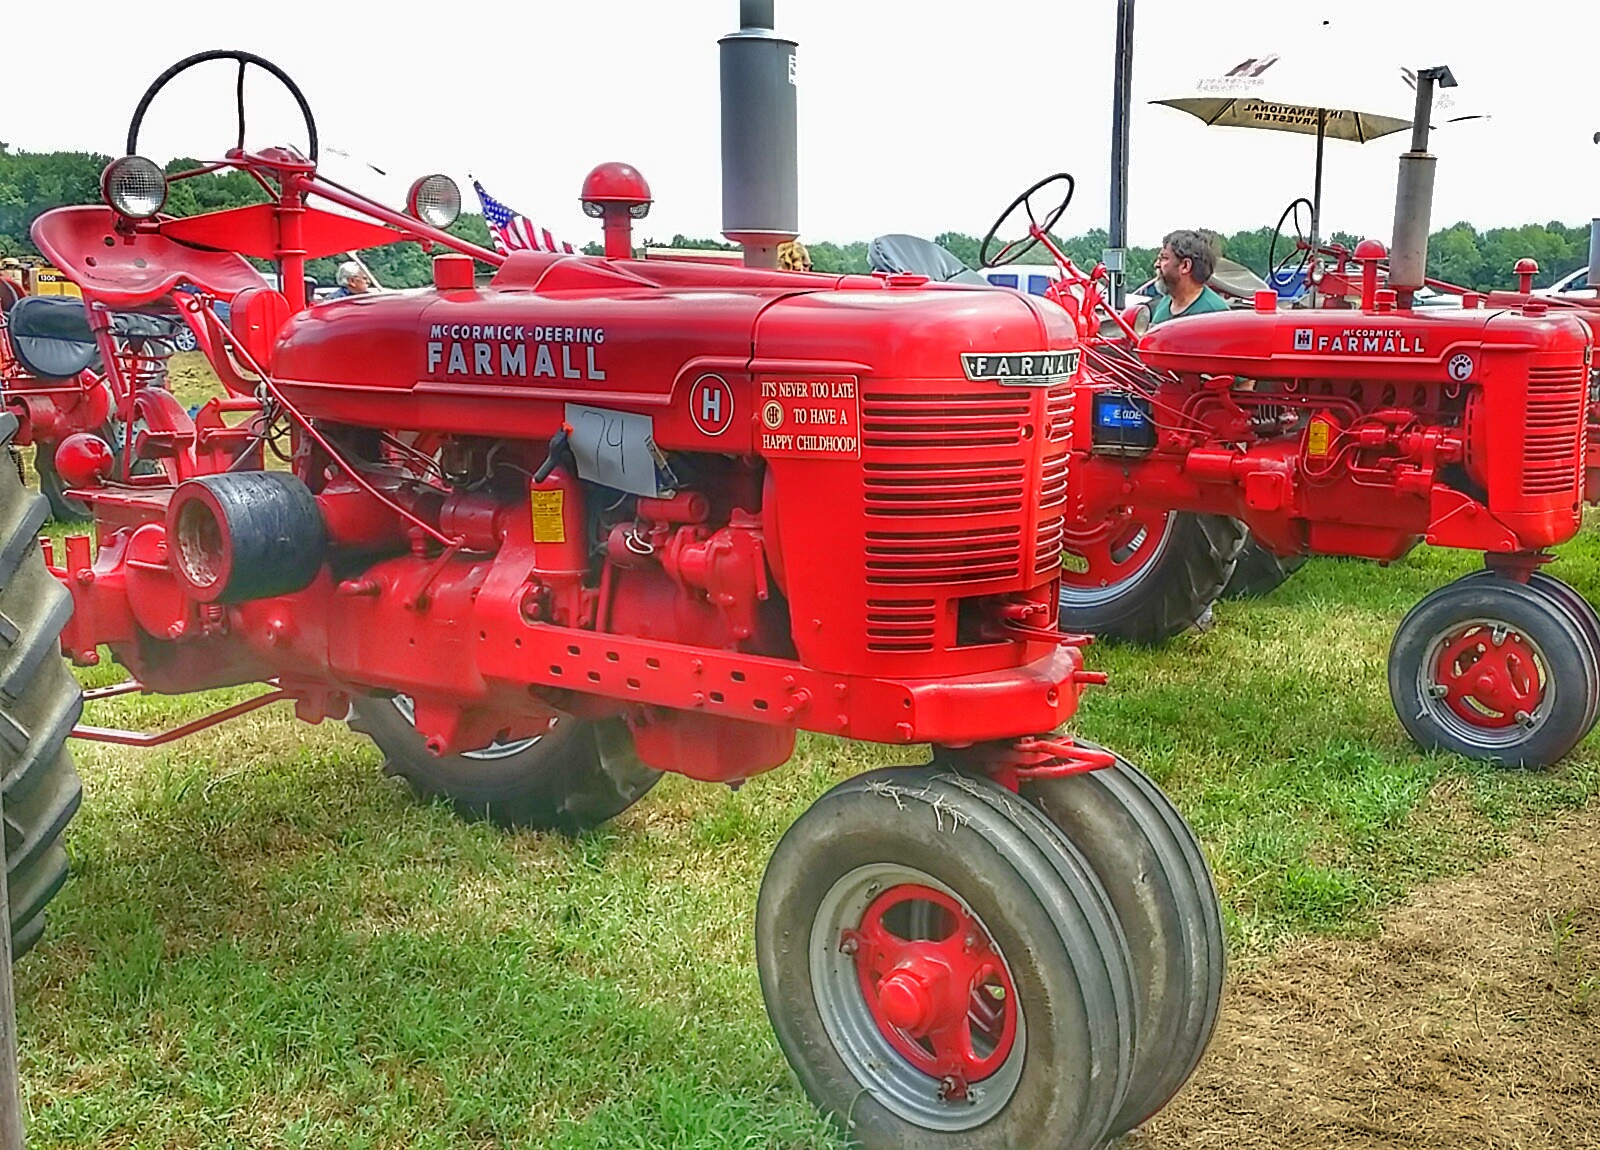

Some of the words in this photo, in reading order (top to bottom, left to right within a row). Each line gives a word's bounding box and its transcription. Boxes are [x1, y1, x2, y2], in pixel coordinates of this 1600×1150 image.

[1318, 337, 1425, 353] FARMALL
[427, 342, 606, 380] FARMALL
[1454, 362, 1467, 379] C
[761, 382, 776, 397] IT'S
[779, 382, 808, 398] NEVER
[811, 383, 829, 398] TOO
[831, 383, 854, 398] LATE
[702, 387, 721, 422] H
[793, 409, 807, 424] TO
[810, 409, 836, 424] HAVE
[839, 410, 848, 425] A
[581, 410, 626, 476] 74
[762, 435, 794, 450] HAPPY
[796, 435, 857, 452] CHILDHOOD!
